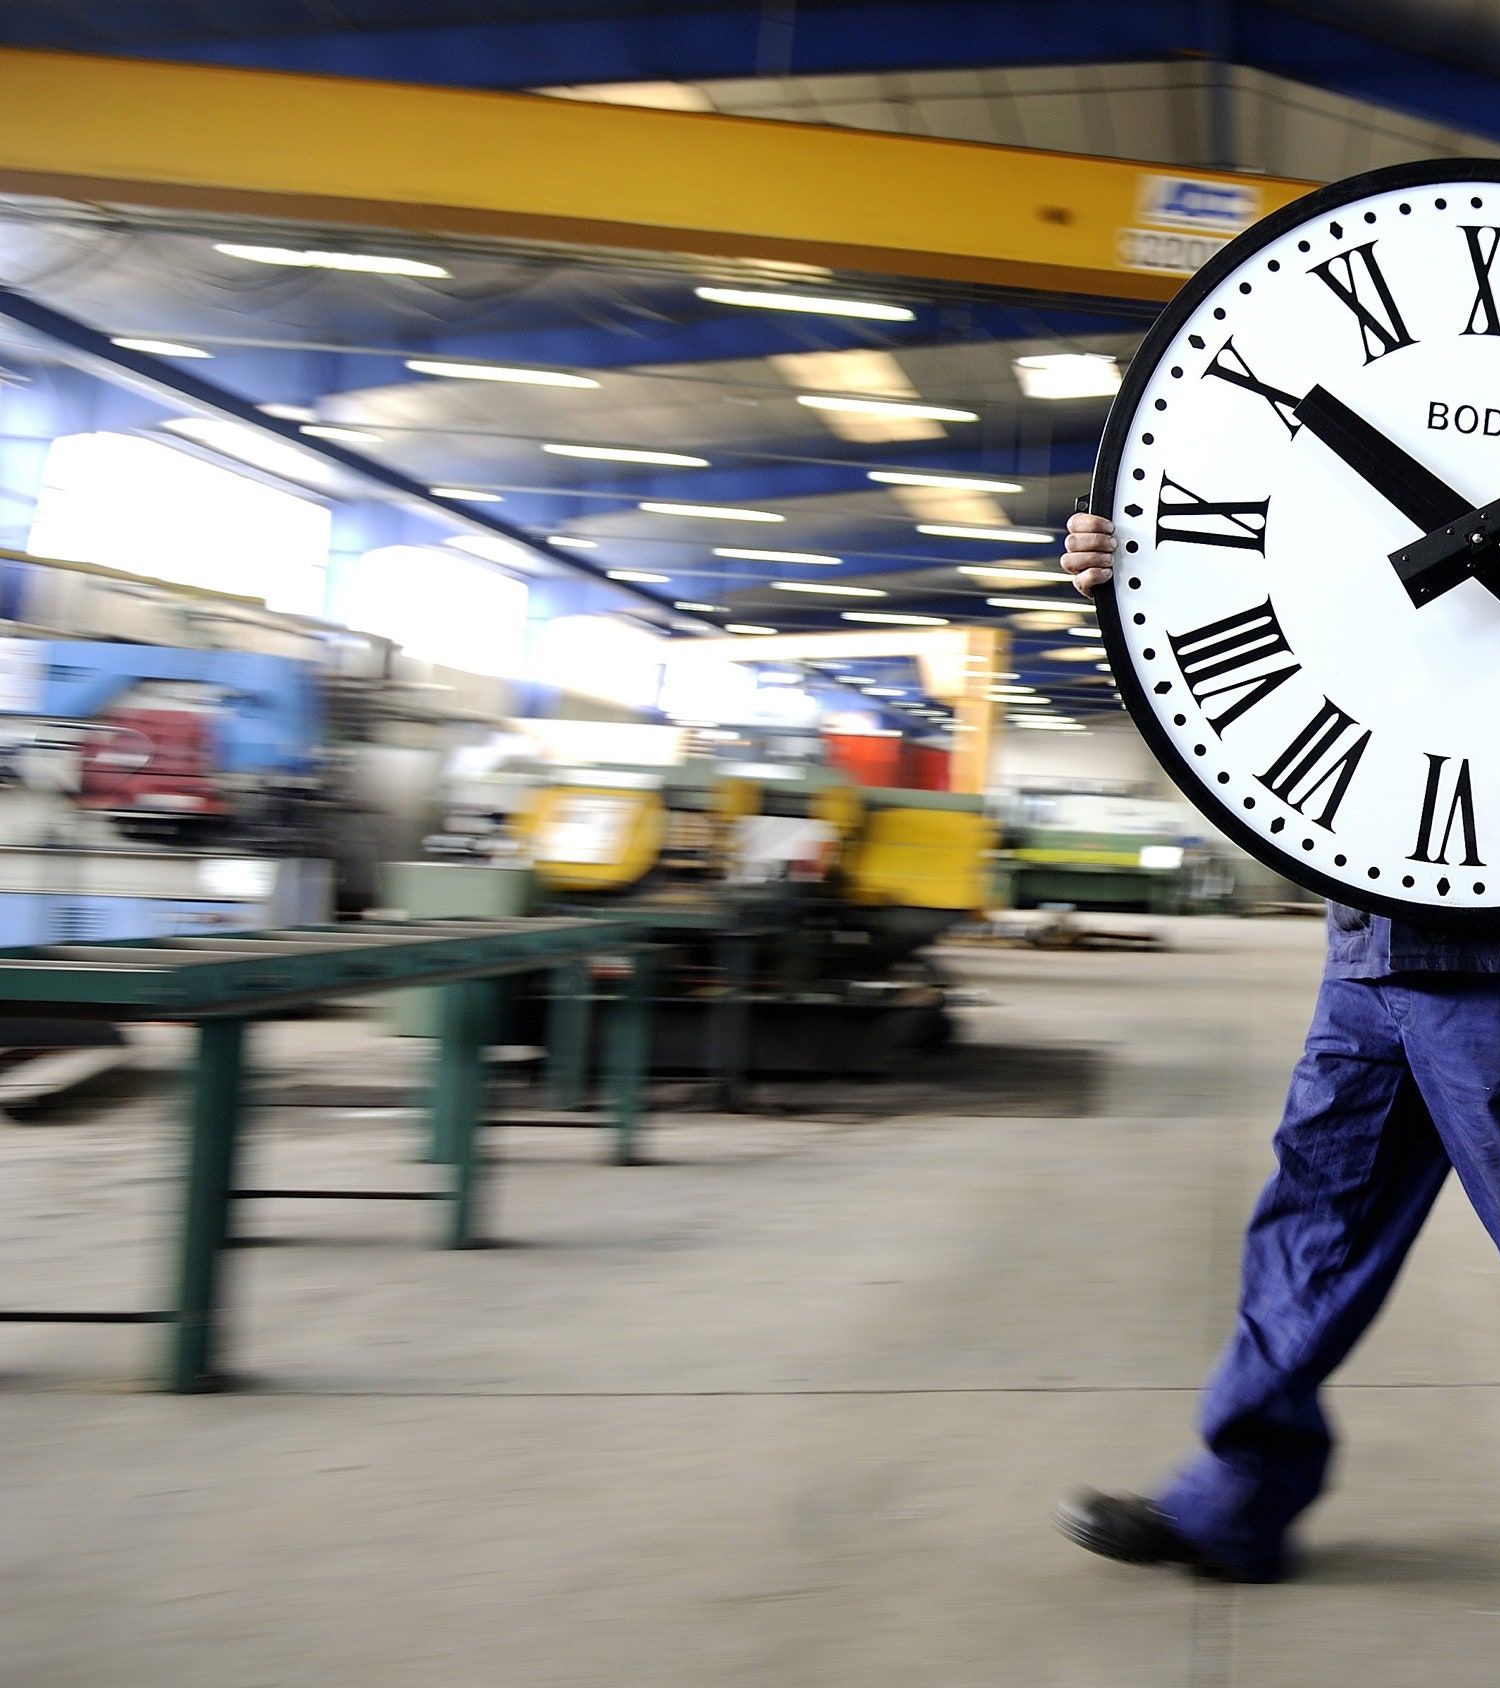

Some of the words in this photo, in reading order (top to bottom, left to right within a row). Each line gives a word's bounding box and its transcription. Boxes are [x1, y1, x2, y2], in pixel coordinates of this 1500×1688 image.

[1305, 240, 1421, 367] XI
[1200, 334, 1305, 442] X
[1155, 469, 1271, 559] IX
[1165, 593, 1303, 742] VIII
[1251, 694, 1374, 836] VII
[1404, 752, 1488, 868] VI
